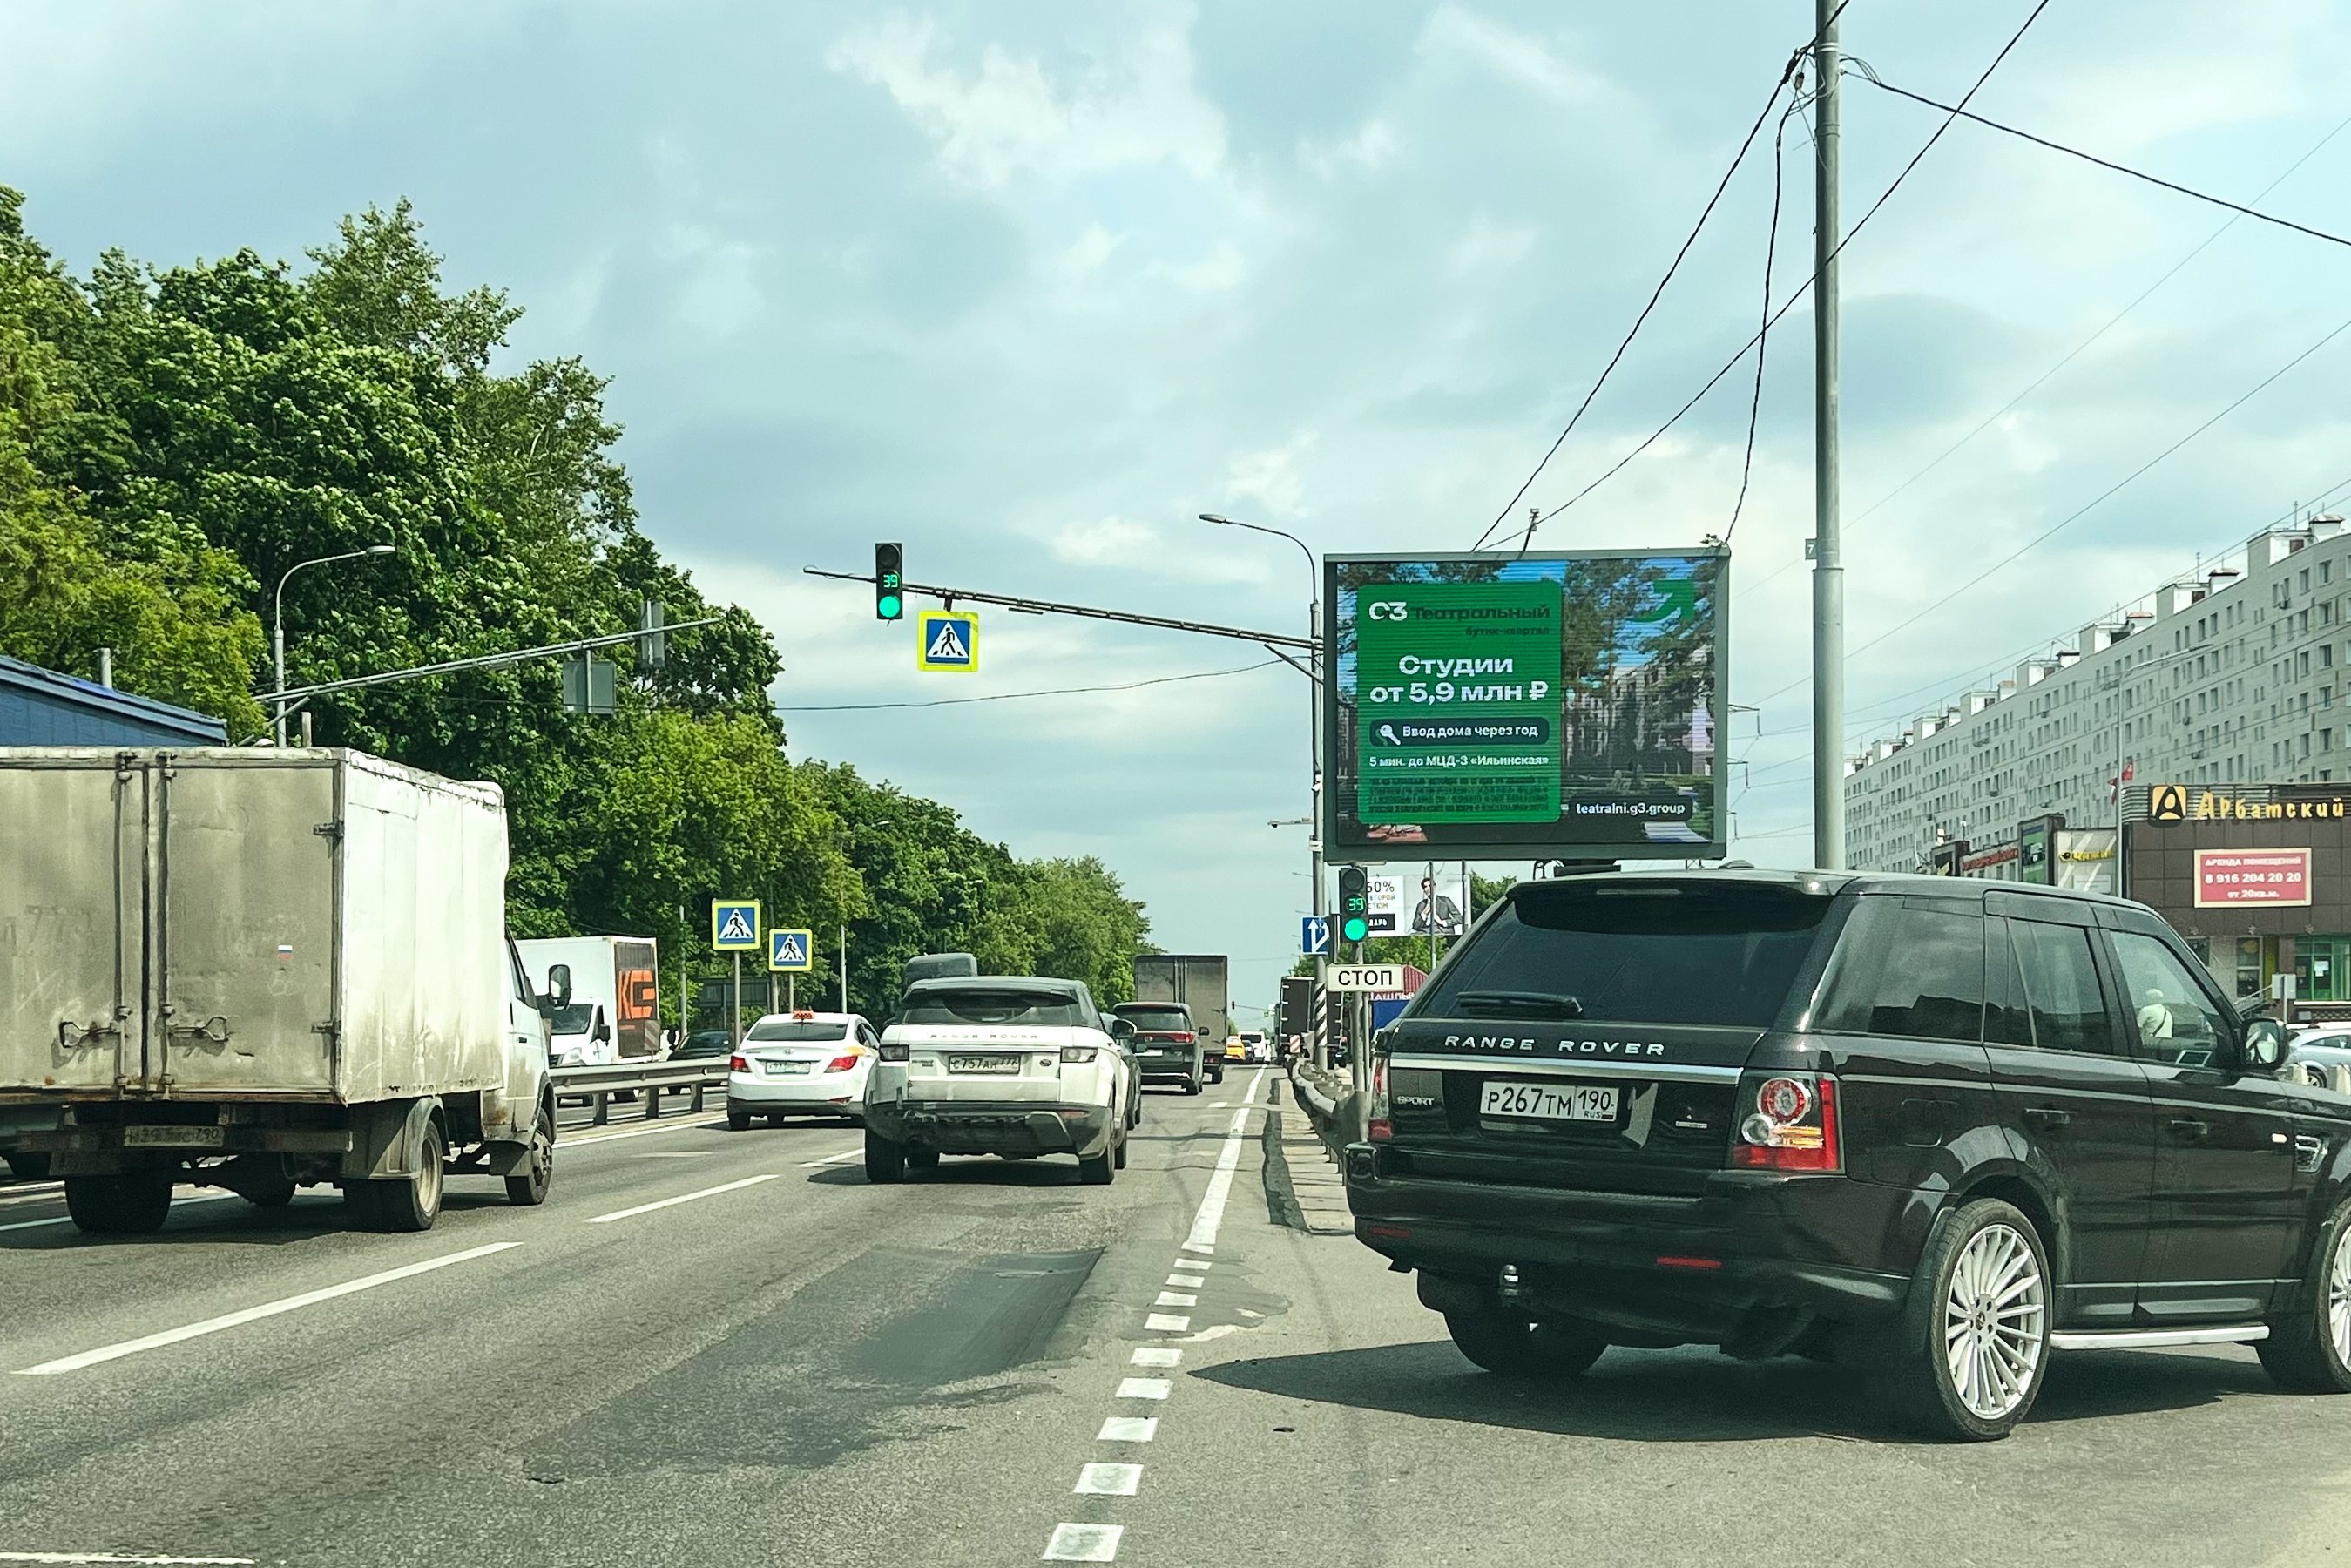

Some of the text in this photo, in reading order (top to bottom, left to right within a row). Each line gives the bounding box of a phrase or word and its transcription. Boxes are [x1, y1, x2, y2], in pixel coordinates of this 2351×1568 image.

[1807, 544, 1814, 555] 7
[883, 574, 898, 588] 39
[1412, 605, 1550, 621] Театральный
[1398, 655, 1513, 678] Студии
[1369, 686, 1404, 703] от
[1409, 682, 1455, 706] 5,9
[1461, 686, 1523, 702] млн
[1402, 726, 1539, 738] Ввод дома через год
[1369, 754, 1549, 768] 5 мин. до МЦД-3 «Ильинская»
[1576, 802, 1686, 816] teatralni.g3.group
[2196, 791, 2345, 820] Арбатский
[2205, 858, 2242, 867] АРЕНДА
[2205, 872, 2302, 883] 8 916 204 20 20
[1348, 898, 1364, 911] 39
[1338, 970, 1392, 985] СТОП
[1444, 1035, 1665, 1056] RANGE ROVER
[1396, 1095, 1436, 1106] SPORT
[1577, 1089, 1611, 1111] 190
[1584, 1110, 1602, 1119] RUS
